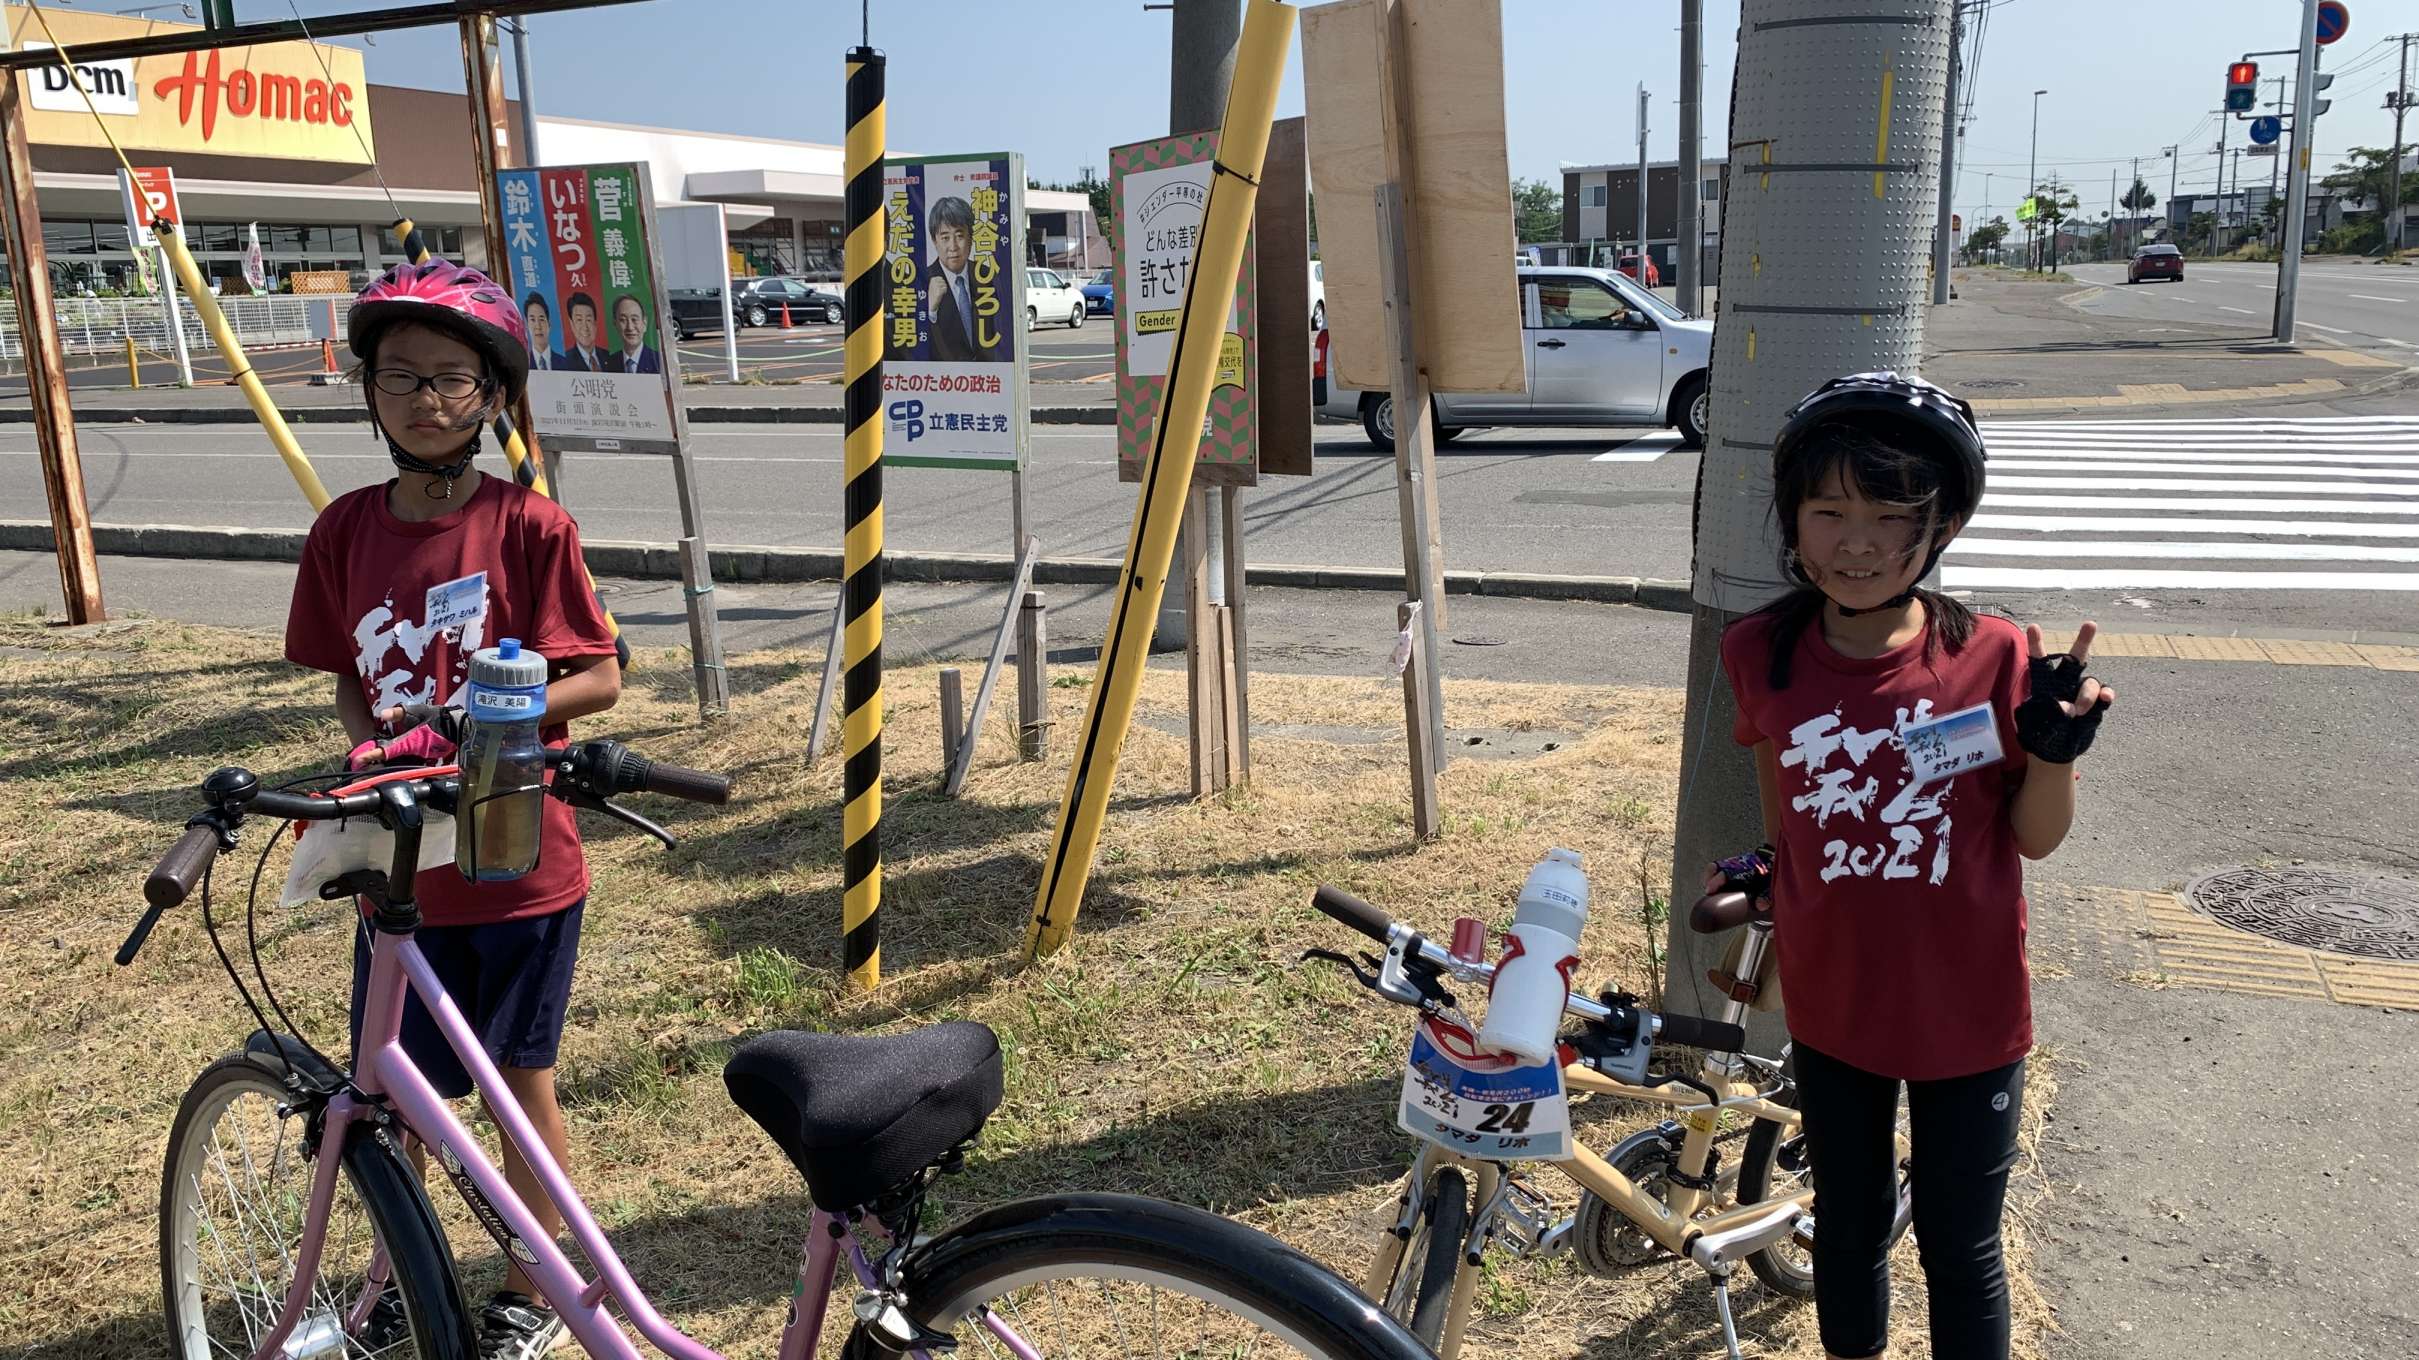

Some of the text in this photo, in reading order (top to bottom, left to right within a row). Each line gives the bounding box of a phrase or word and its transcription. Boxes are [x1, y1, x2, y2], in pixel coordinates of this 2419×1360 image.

[153, 47, 354, 142] Homac
[145, 191, 167, 221] P
[999, 191, 1009, 247] かみや
[889, 191, 918, 348] えだの幸男
[970, 186, 1001, 348] 神谷ひろし
[1139, 313, 1176, 328] Gender
[571, 378, 618, 399] 公明党
[929, 412, 1008, 433] 立憲民主党
[1820, 815, 1952, 886] 2021
[1434, 1122, 1482, 1144] タマダ
[1475, 1101, 1536, 1134] 24
